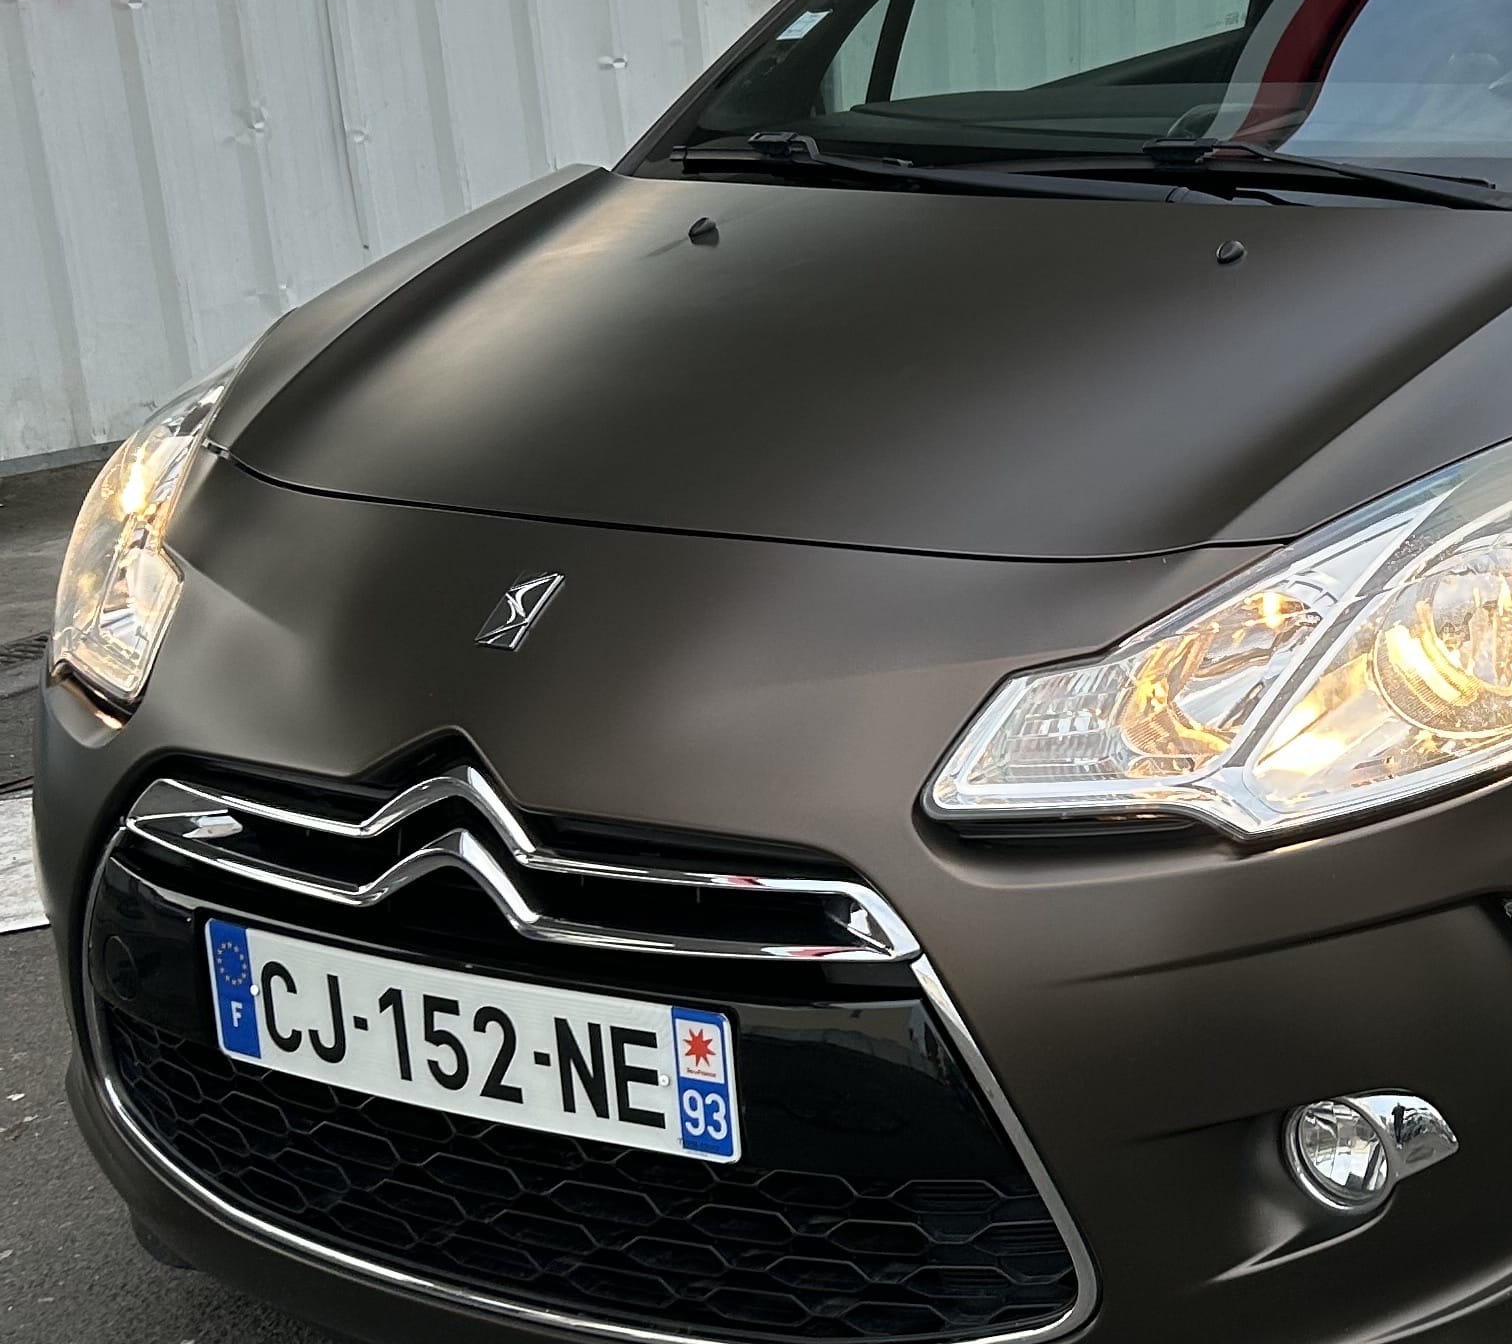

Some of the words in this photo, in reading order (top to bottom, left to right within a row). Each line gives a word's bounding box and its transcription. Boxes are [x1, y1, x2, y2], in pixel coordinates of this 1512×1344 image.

[230, 1000, 243, 1028] F
[260, 960, 667, 1131] CJ-152-NE
[682, 1088, 728, 1141] 93
